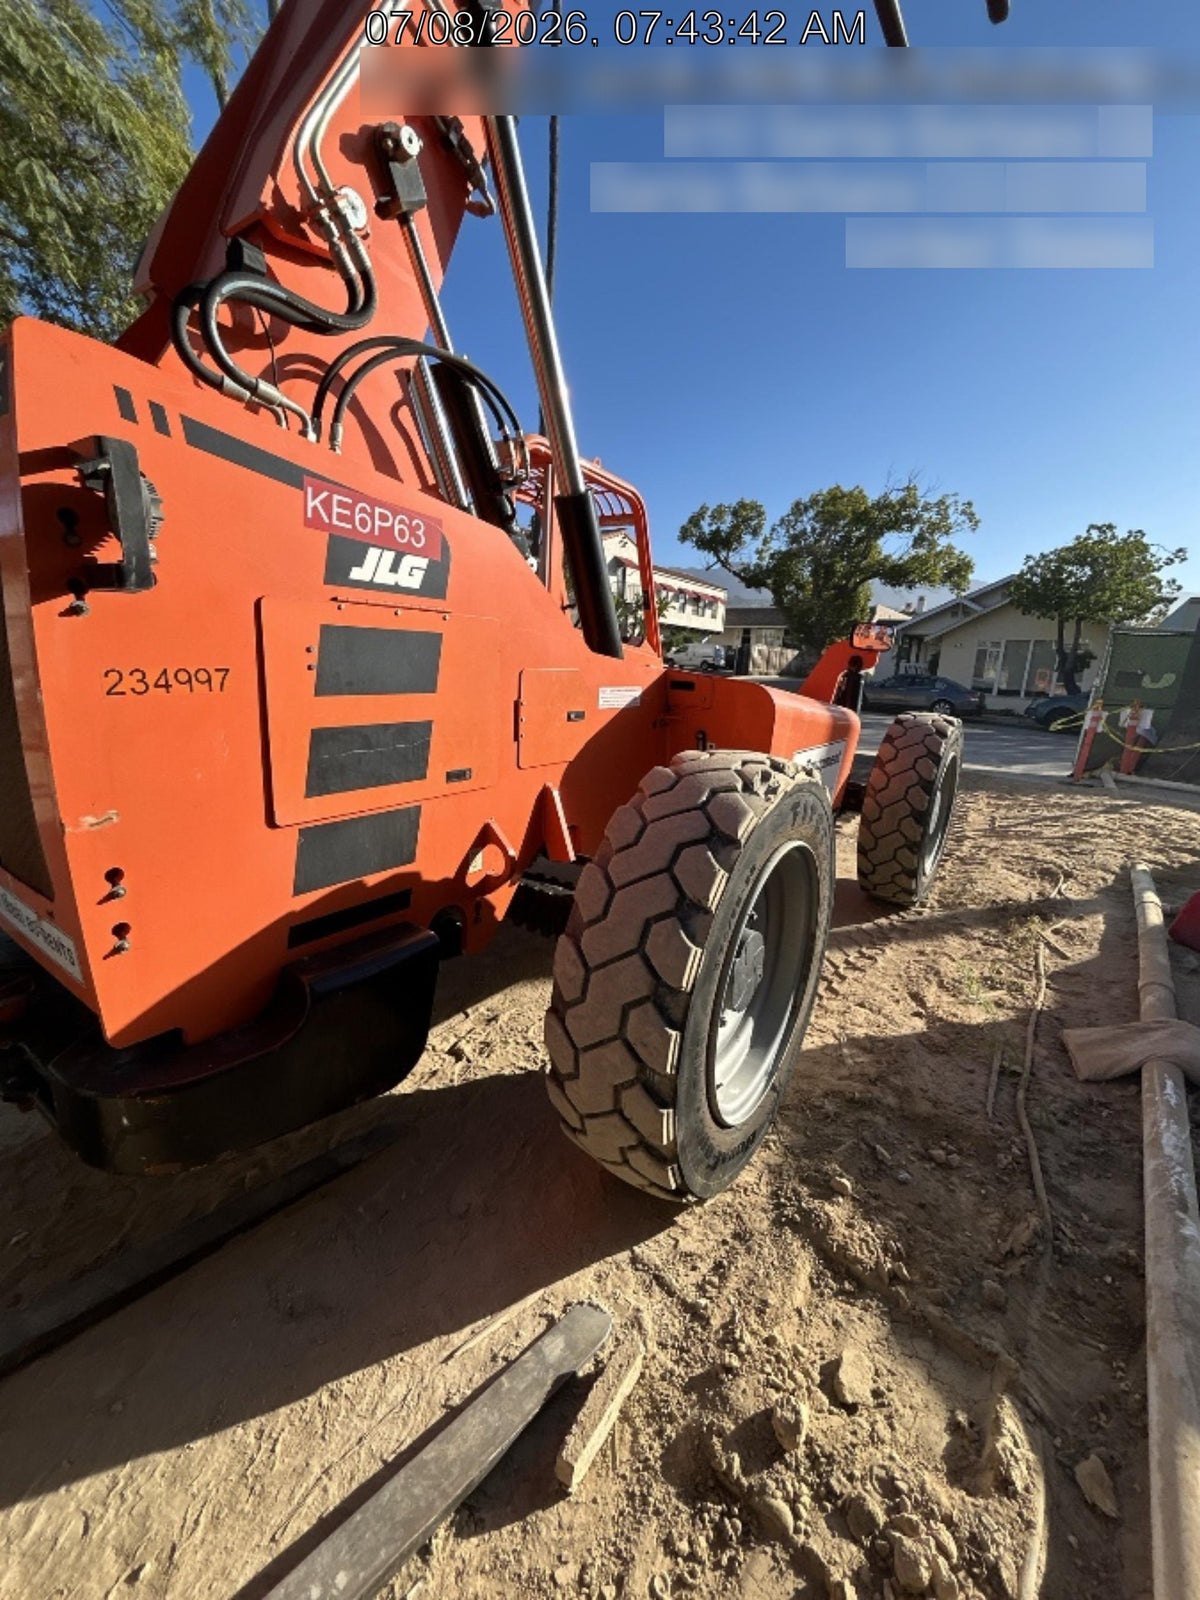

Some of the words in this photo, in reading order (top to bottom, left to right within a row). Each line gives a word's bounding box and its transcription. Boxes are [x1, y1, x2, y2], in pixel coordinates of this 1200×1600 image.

[306, 486, 426, 548] KE6P63
[348, 546, 430, 589] JLG
[103, 667, 231, 696] 234997
